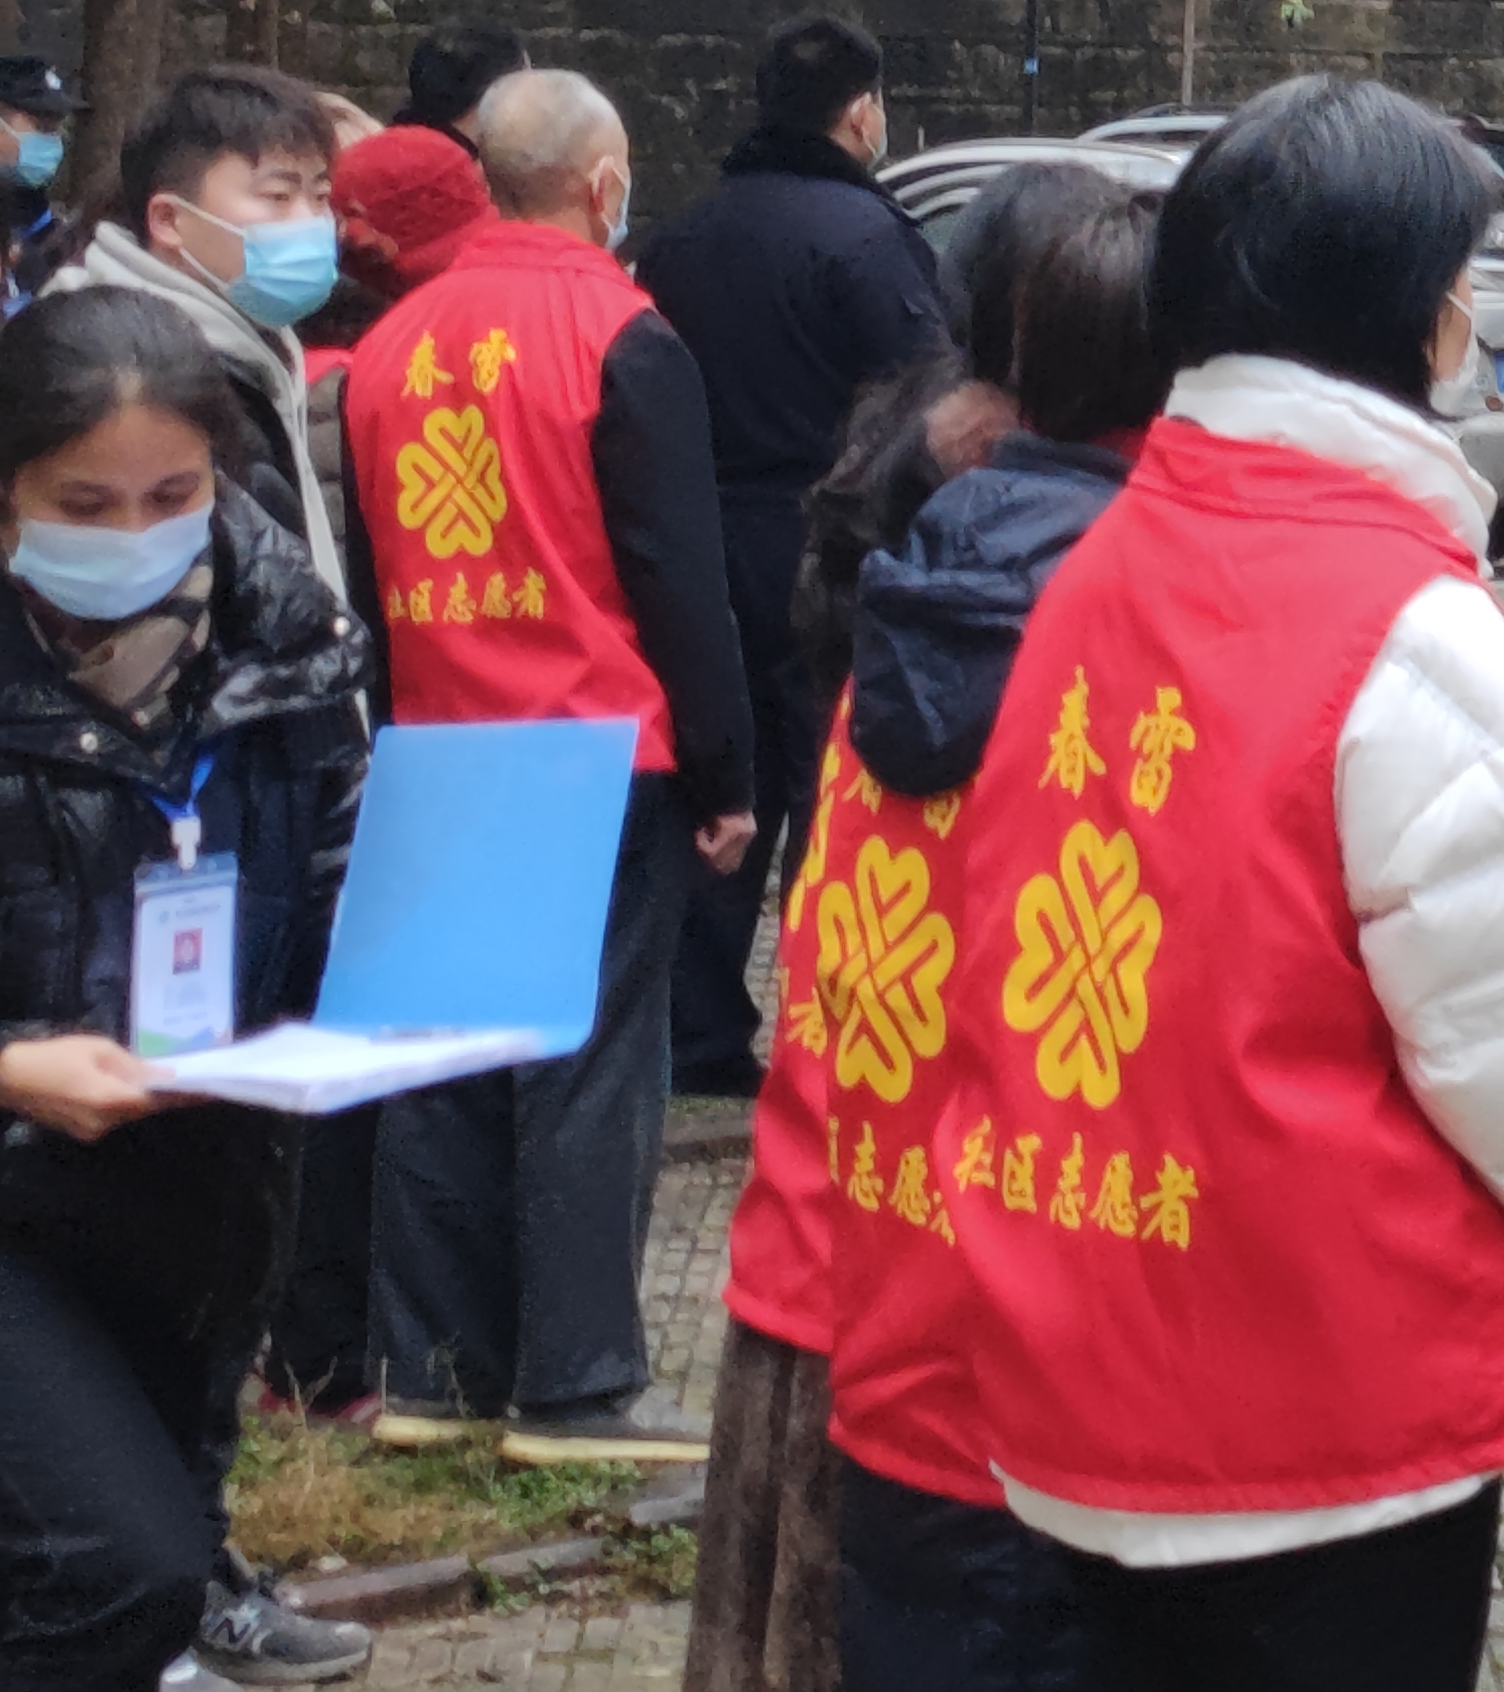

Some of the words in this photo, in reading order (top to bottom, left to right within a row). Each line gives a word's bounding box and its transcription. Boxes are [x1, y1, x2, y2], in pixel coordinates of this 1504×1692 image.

[1037, 664, 1197, 816] 春雷
[952, 1113, 1200, 1251] 社区志愿者
